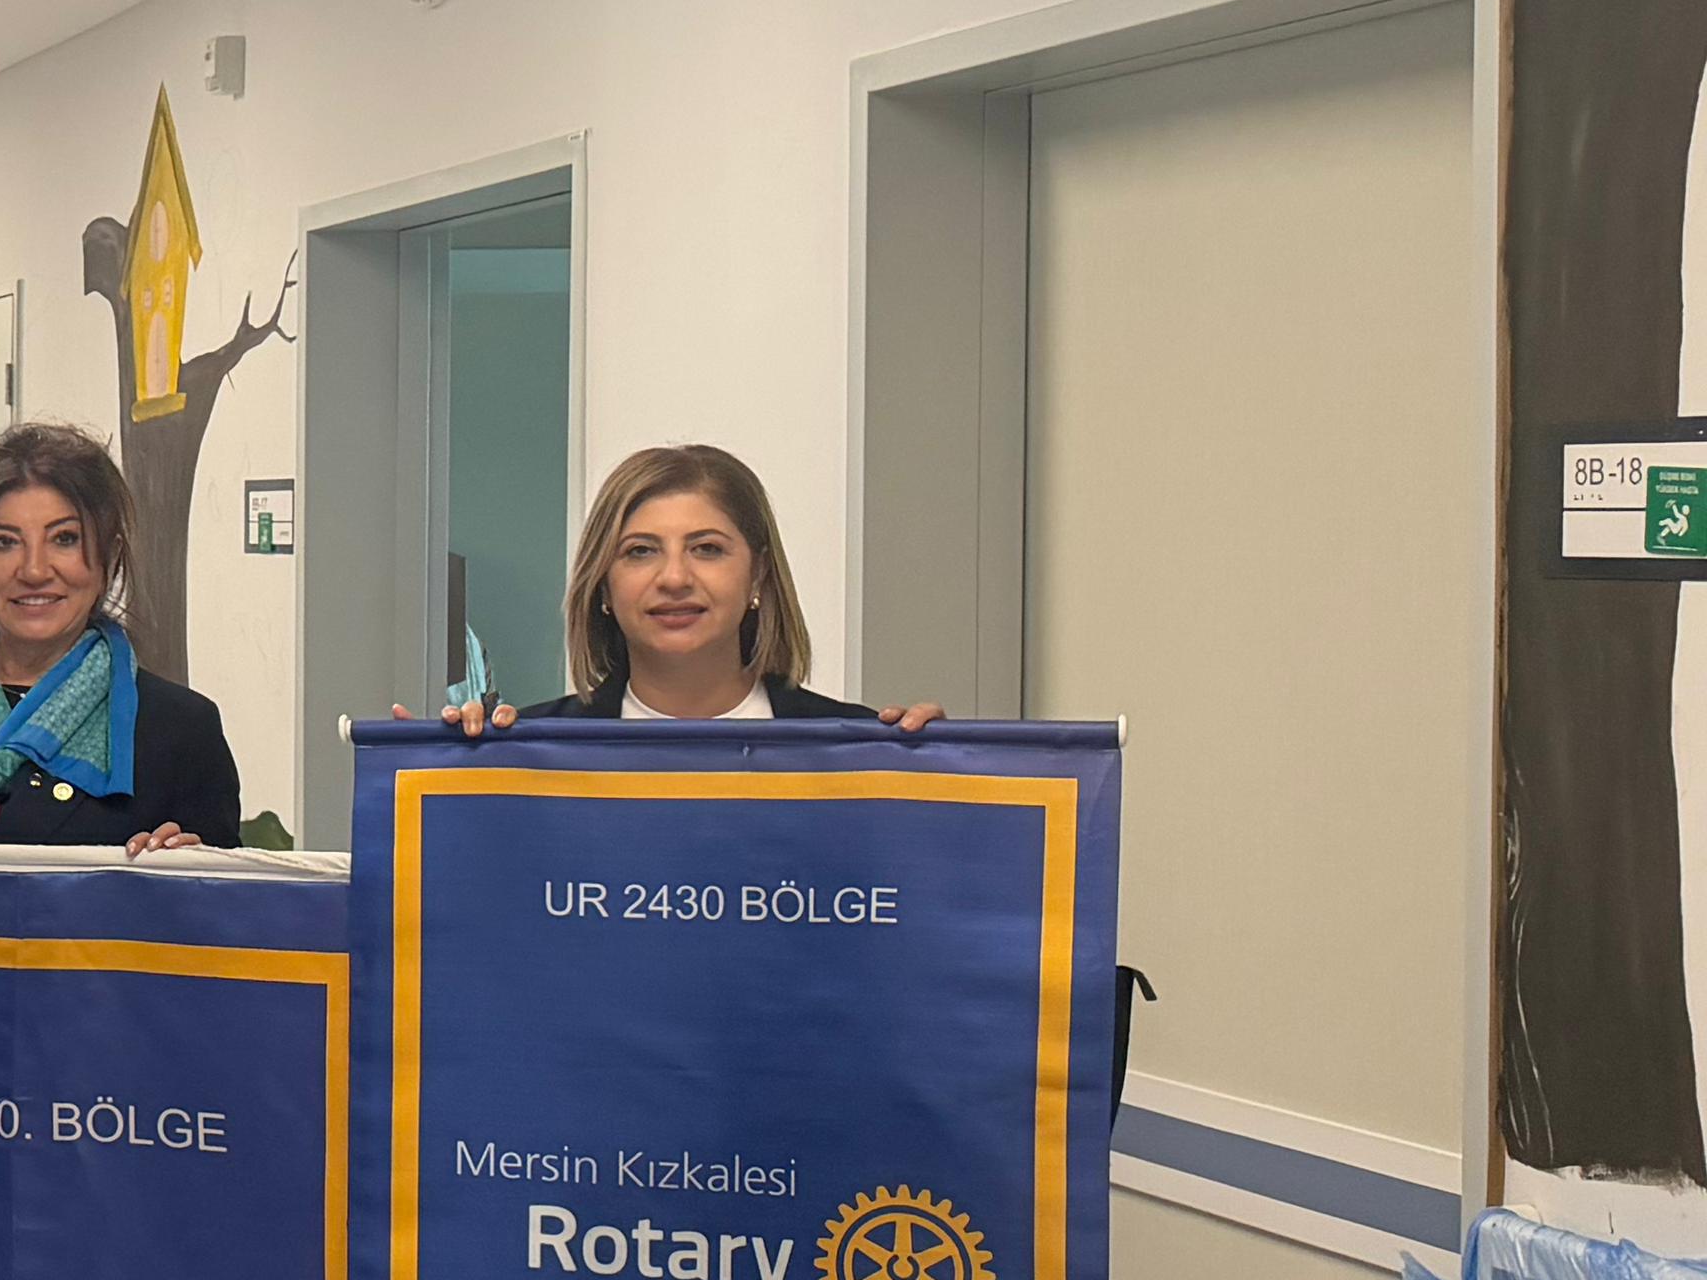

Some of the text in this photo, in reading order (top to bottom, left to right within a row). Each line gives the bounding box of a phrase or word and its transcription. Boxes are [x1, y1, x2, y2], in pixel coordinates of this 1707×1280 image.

[1575, 457, 1642, 485] 8B-18
[544, 879, 898, 923] UR 2430 BÖLGE
[52, 1096, 228, 1152] BÖLGE
[454, 1140, 798, 1197] Mersin Kızkalesi
